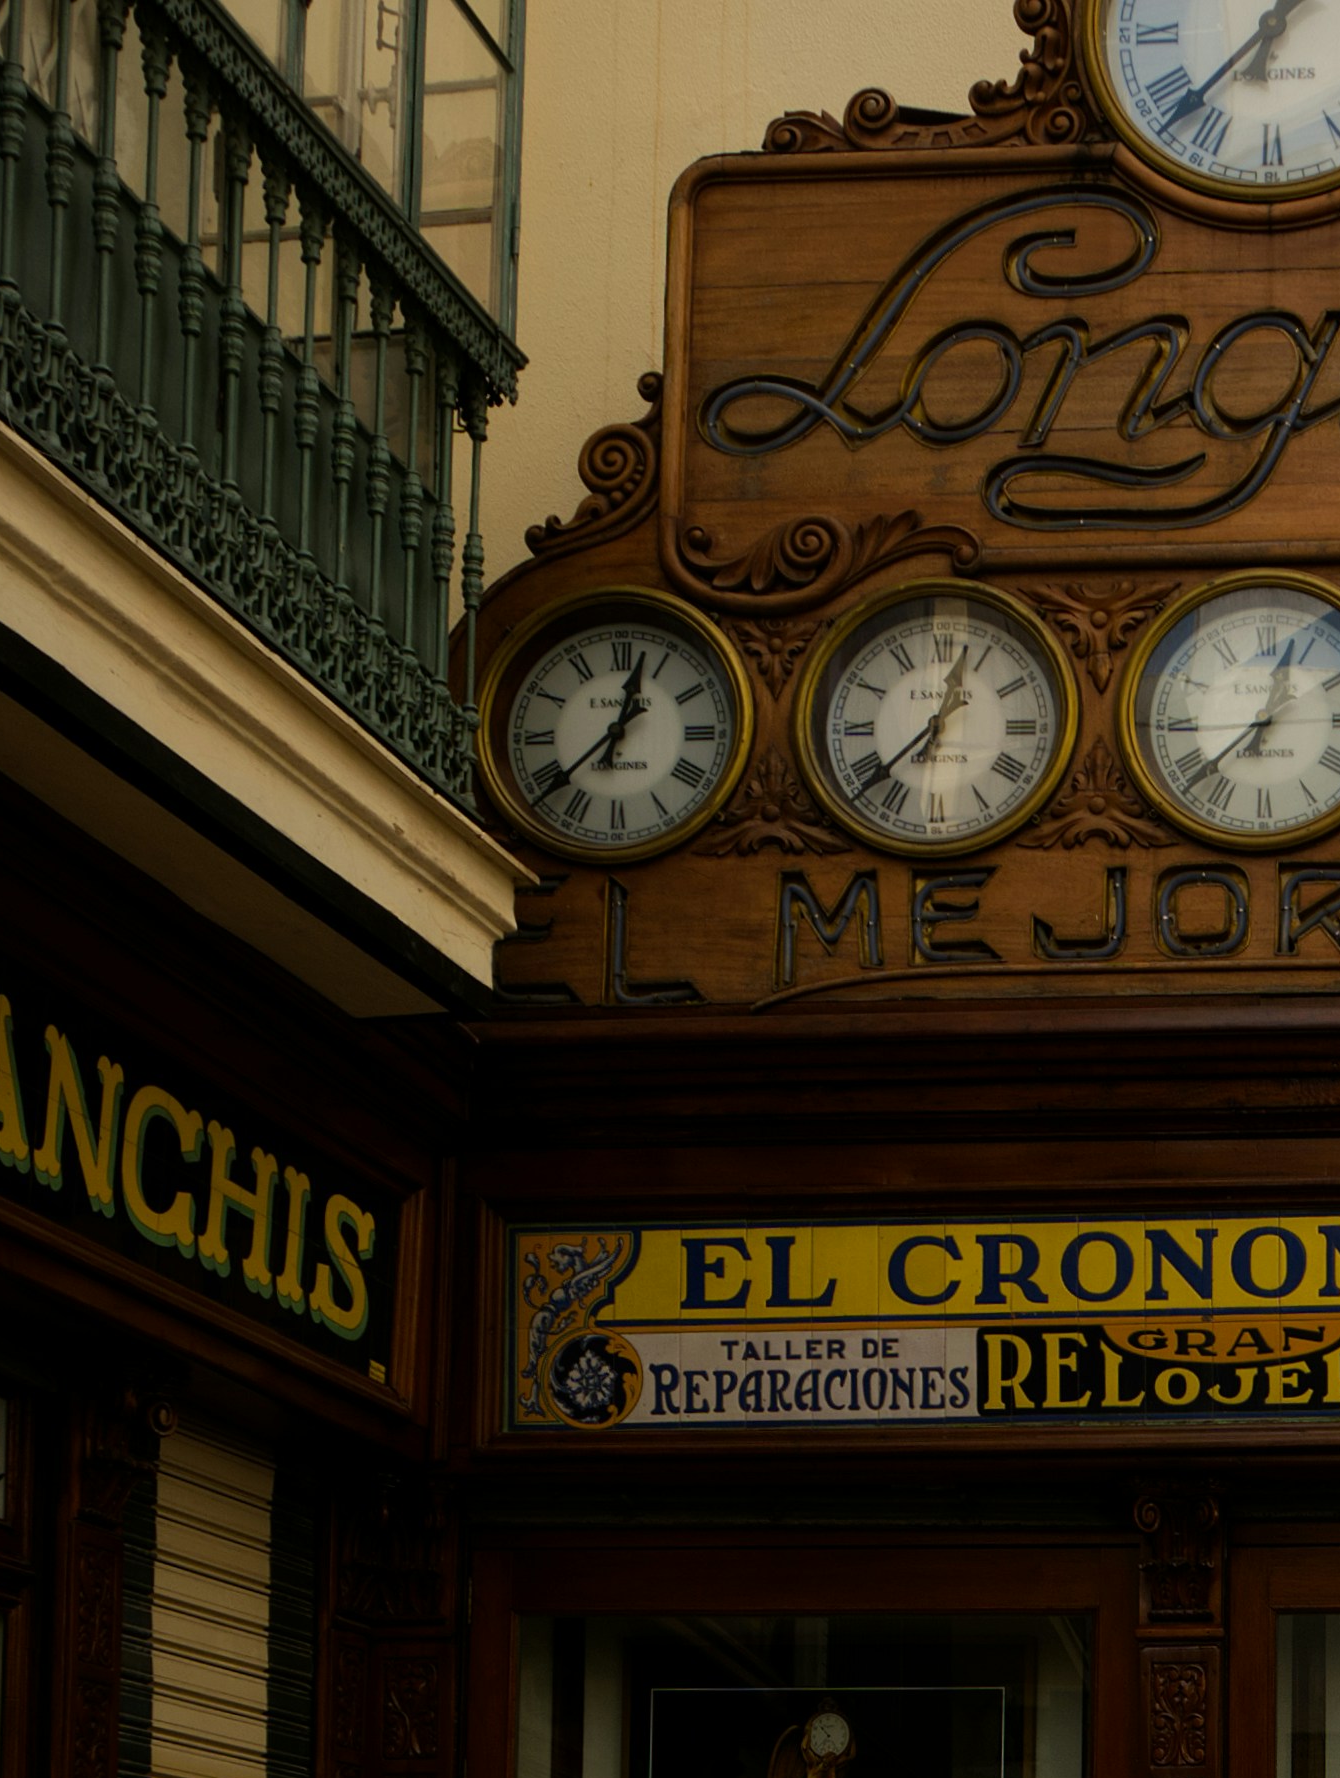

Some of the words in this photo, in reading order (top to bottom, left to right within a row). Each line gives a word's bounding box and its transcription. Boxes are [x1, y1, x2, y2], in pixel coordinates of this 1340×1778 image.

[1232, 68, 1316, 81] LOGINES
[1245, 684, 1298, 694] SANIS
[920, 690, 973, 700] SANIS
[601, 698, 651, 708] SANIS
[911, 754, 968, 764] LOGINES
[591, 761, 647, 770] LOGINES
[679, 1235, 837, 1309] EL
[1126, 1325, 1328, 1357] GRAN
[720, 1338, 844, 1361] TALLER
[862, 1337, 899, 1359] DE
[649, 1362, 971, 1417] REPARACIONES
